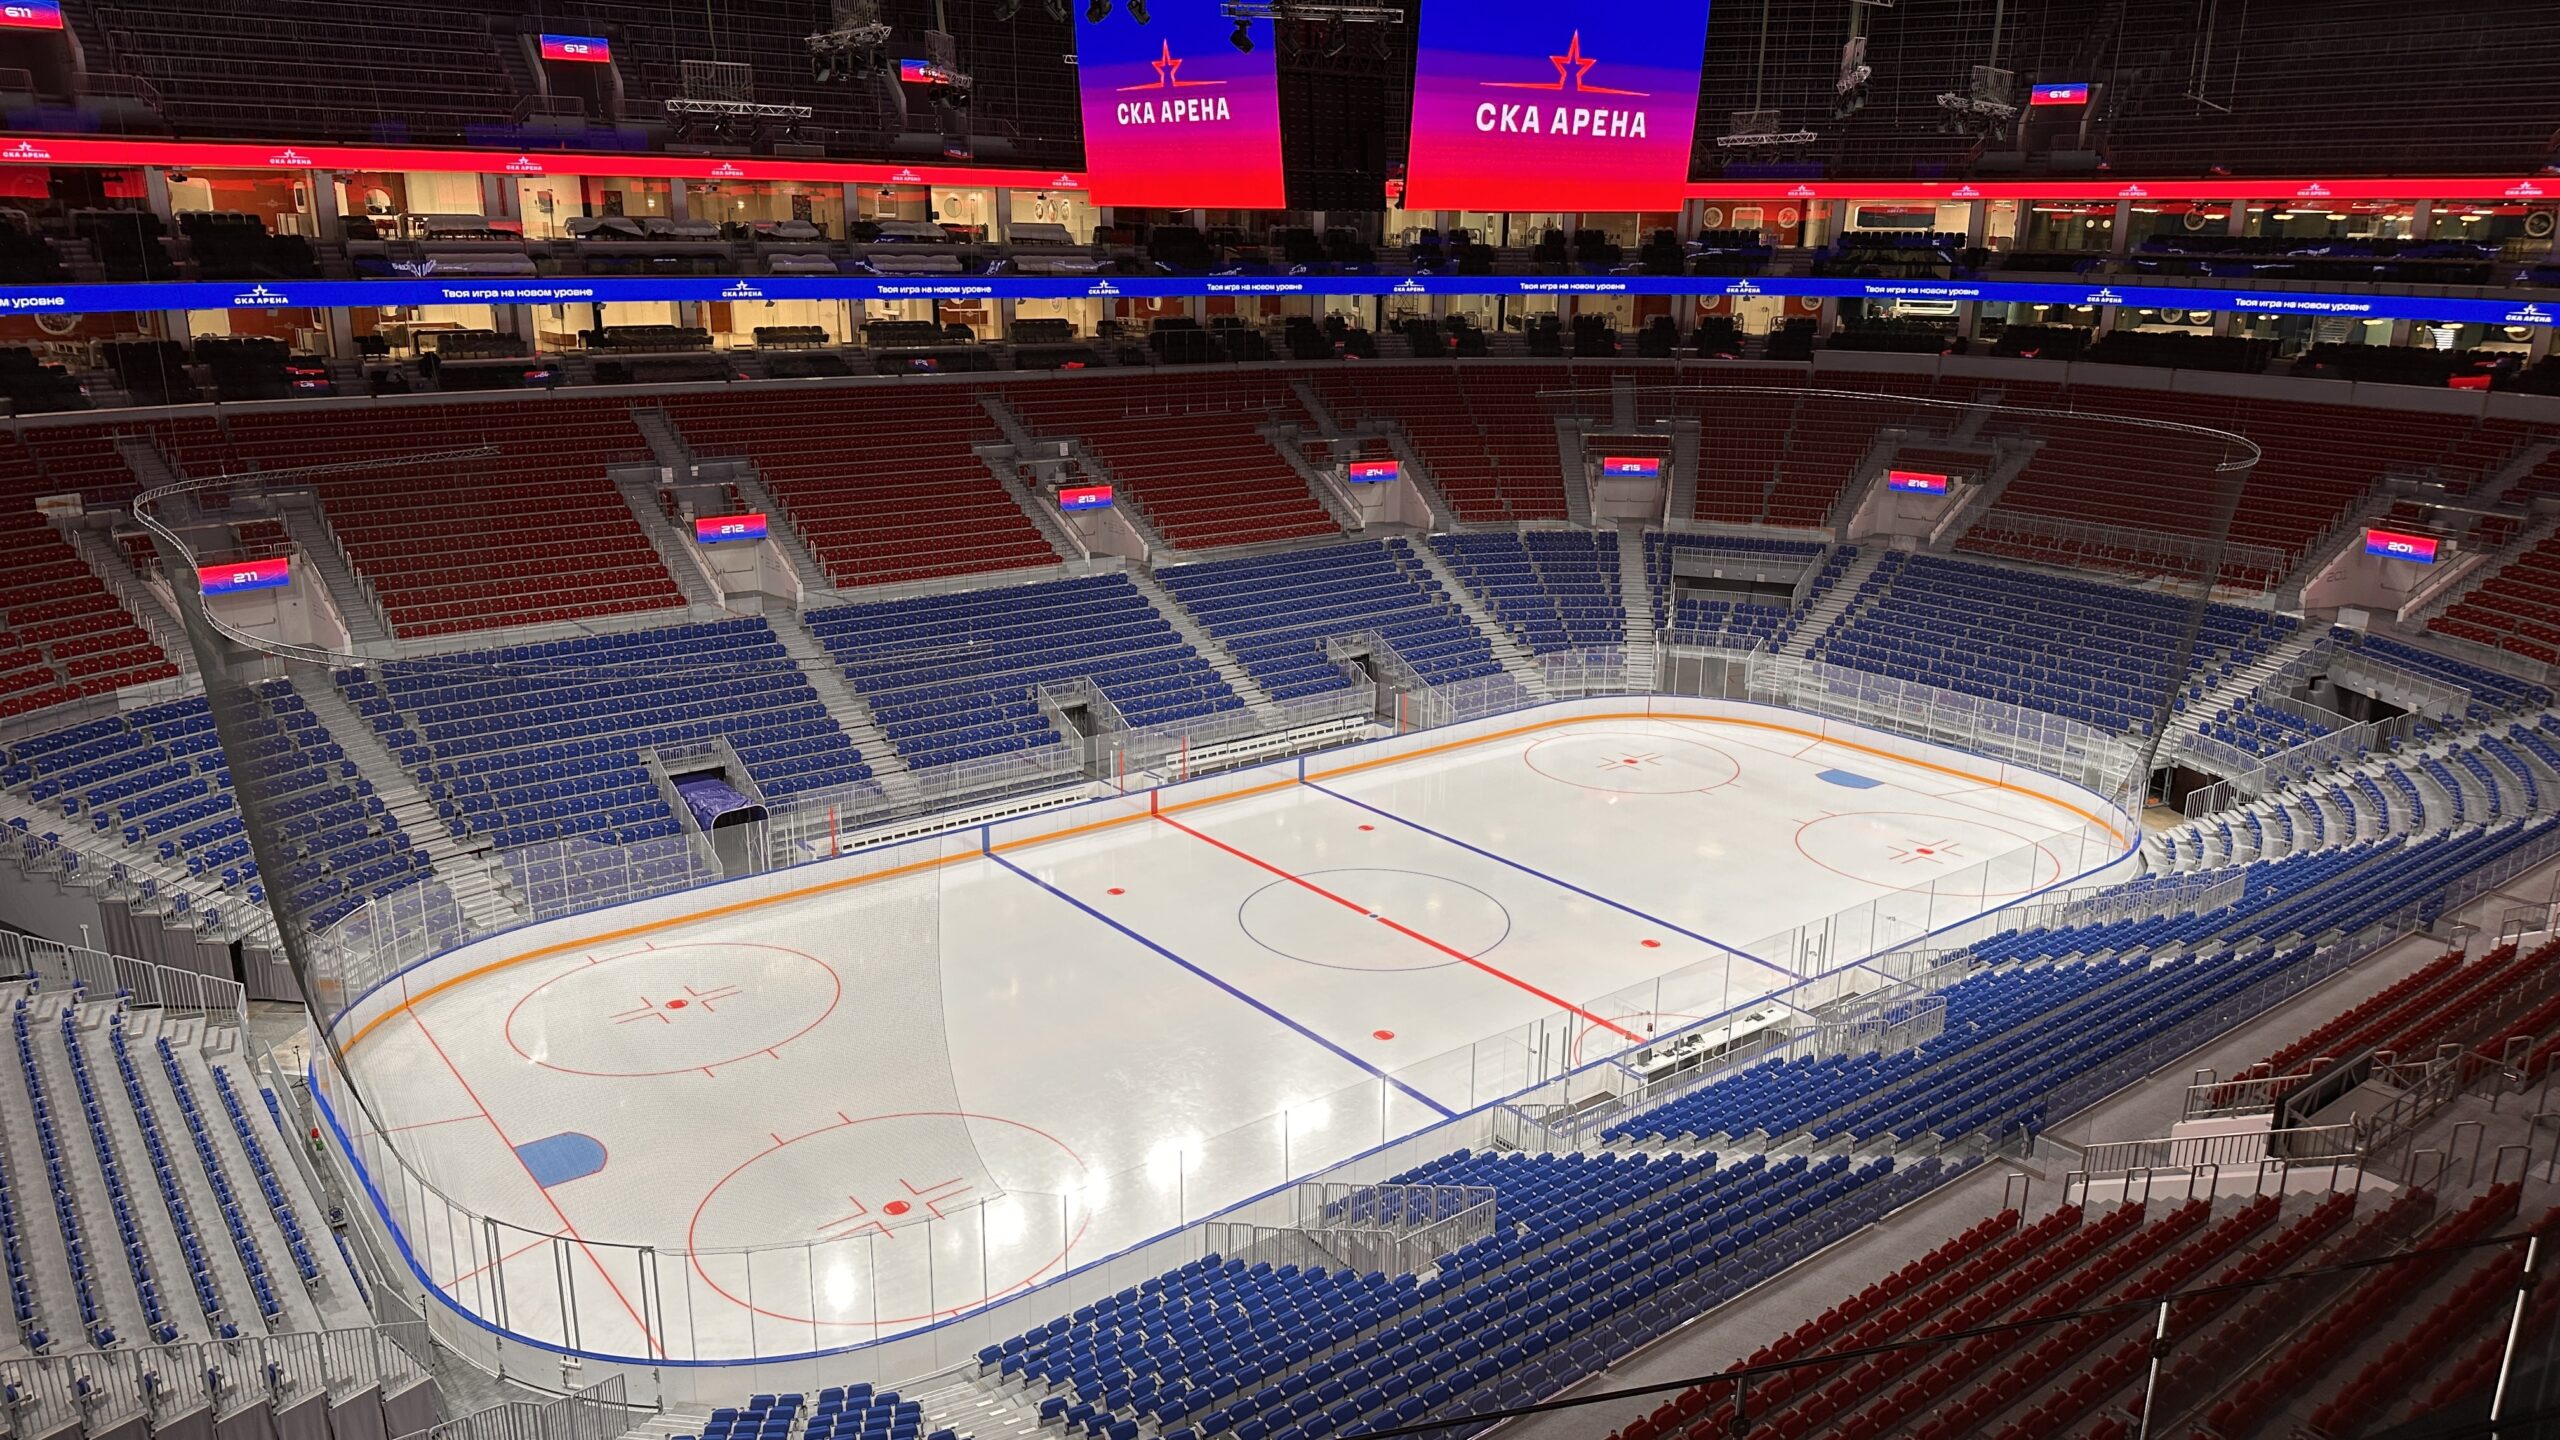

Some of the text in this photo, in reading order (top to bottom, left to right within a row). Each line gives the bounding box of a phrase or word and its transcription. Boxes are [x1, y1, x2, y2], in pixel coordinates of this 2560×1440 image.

[4, 7, 32, 19] 611
[564, 43, 588, 54] 612
[2050, 90, 2070, 99] 616
[1117, 98, 1231, 125] СКА АРЕНА
[1476, 103, 1646, 138] СКА АРЕНА
[878, 285, 991, 295] Твоя игра на новом уровне
[1207, 283, 1223, 291] Твоя
[1224, 284, 1240, 292] игра
[1276, 283, 1302, 292] уровне
[1520, 282, 1538, 290] Твоя
[1540, 283, 1558, 291] игра
[1597, 283, 1625, 291] уровне
[1866, 285, 1885, 294] Твоя
[1886, 287, 1906, 295] игра
[1920, 287, 1947, 295] новом
[1949, 288, 1979, 297] уровне
[442, 288, 593, 299] Твоя игра на новом уровне
[11, 297, 65, 309] уровне
[235, 297, 255, 305] СКА
[2236, 298, 2370, 312] Твоя игра на новом уровне
[2506, 314, 2551, 323] СКА АРЕНА
[1367, 468, 1382, 477] 214
[1622, 463, 1640, 472] 215
[1908, 479, 1928, 489] 216
[1078, 494, 1095, 504] 213
[721, 524, 745, 535] 212
[2387, 542, 2414, 554] 201
[233, 572, 258, 584] 211
